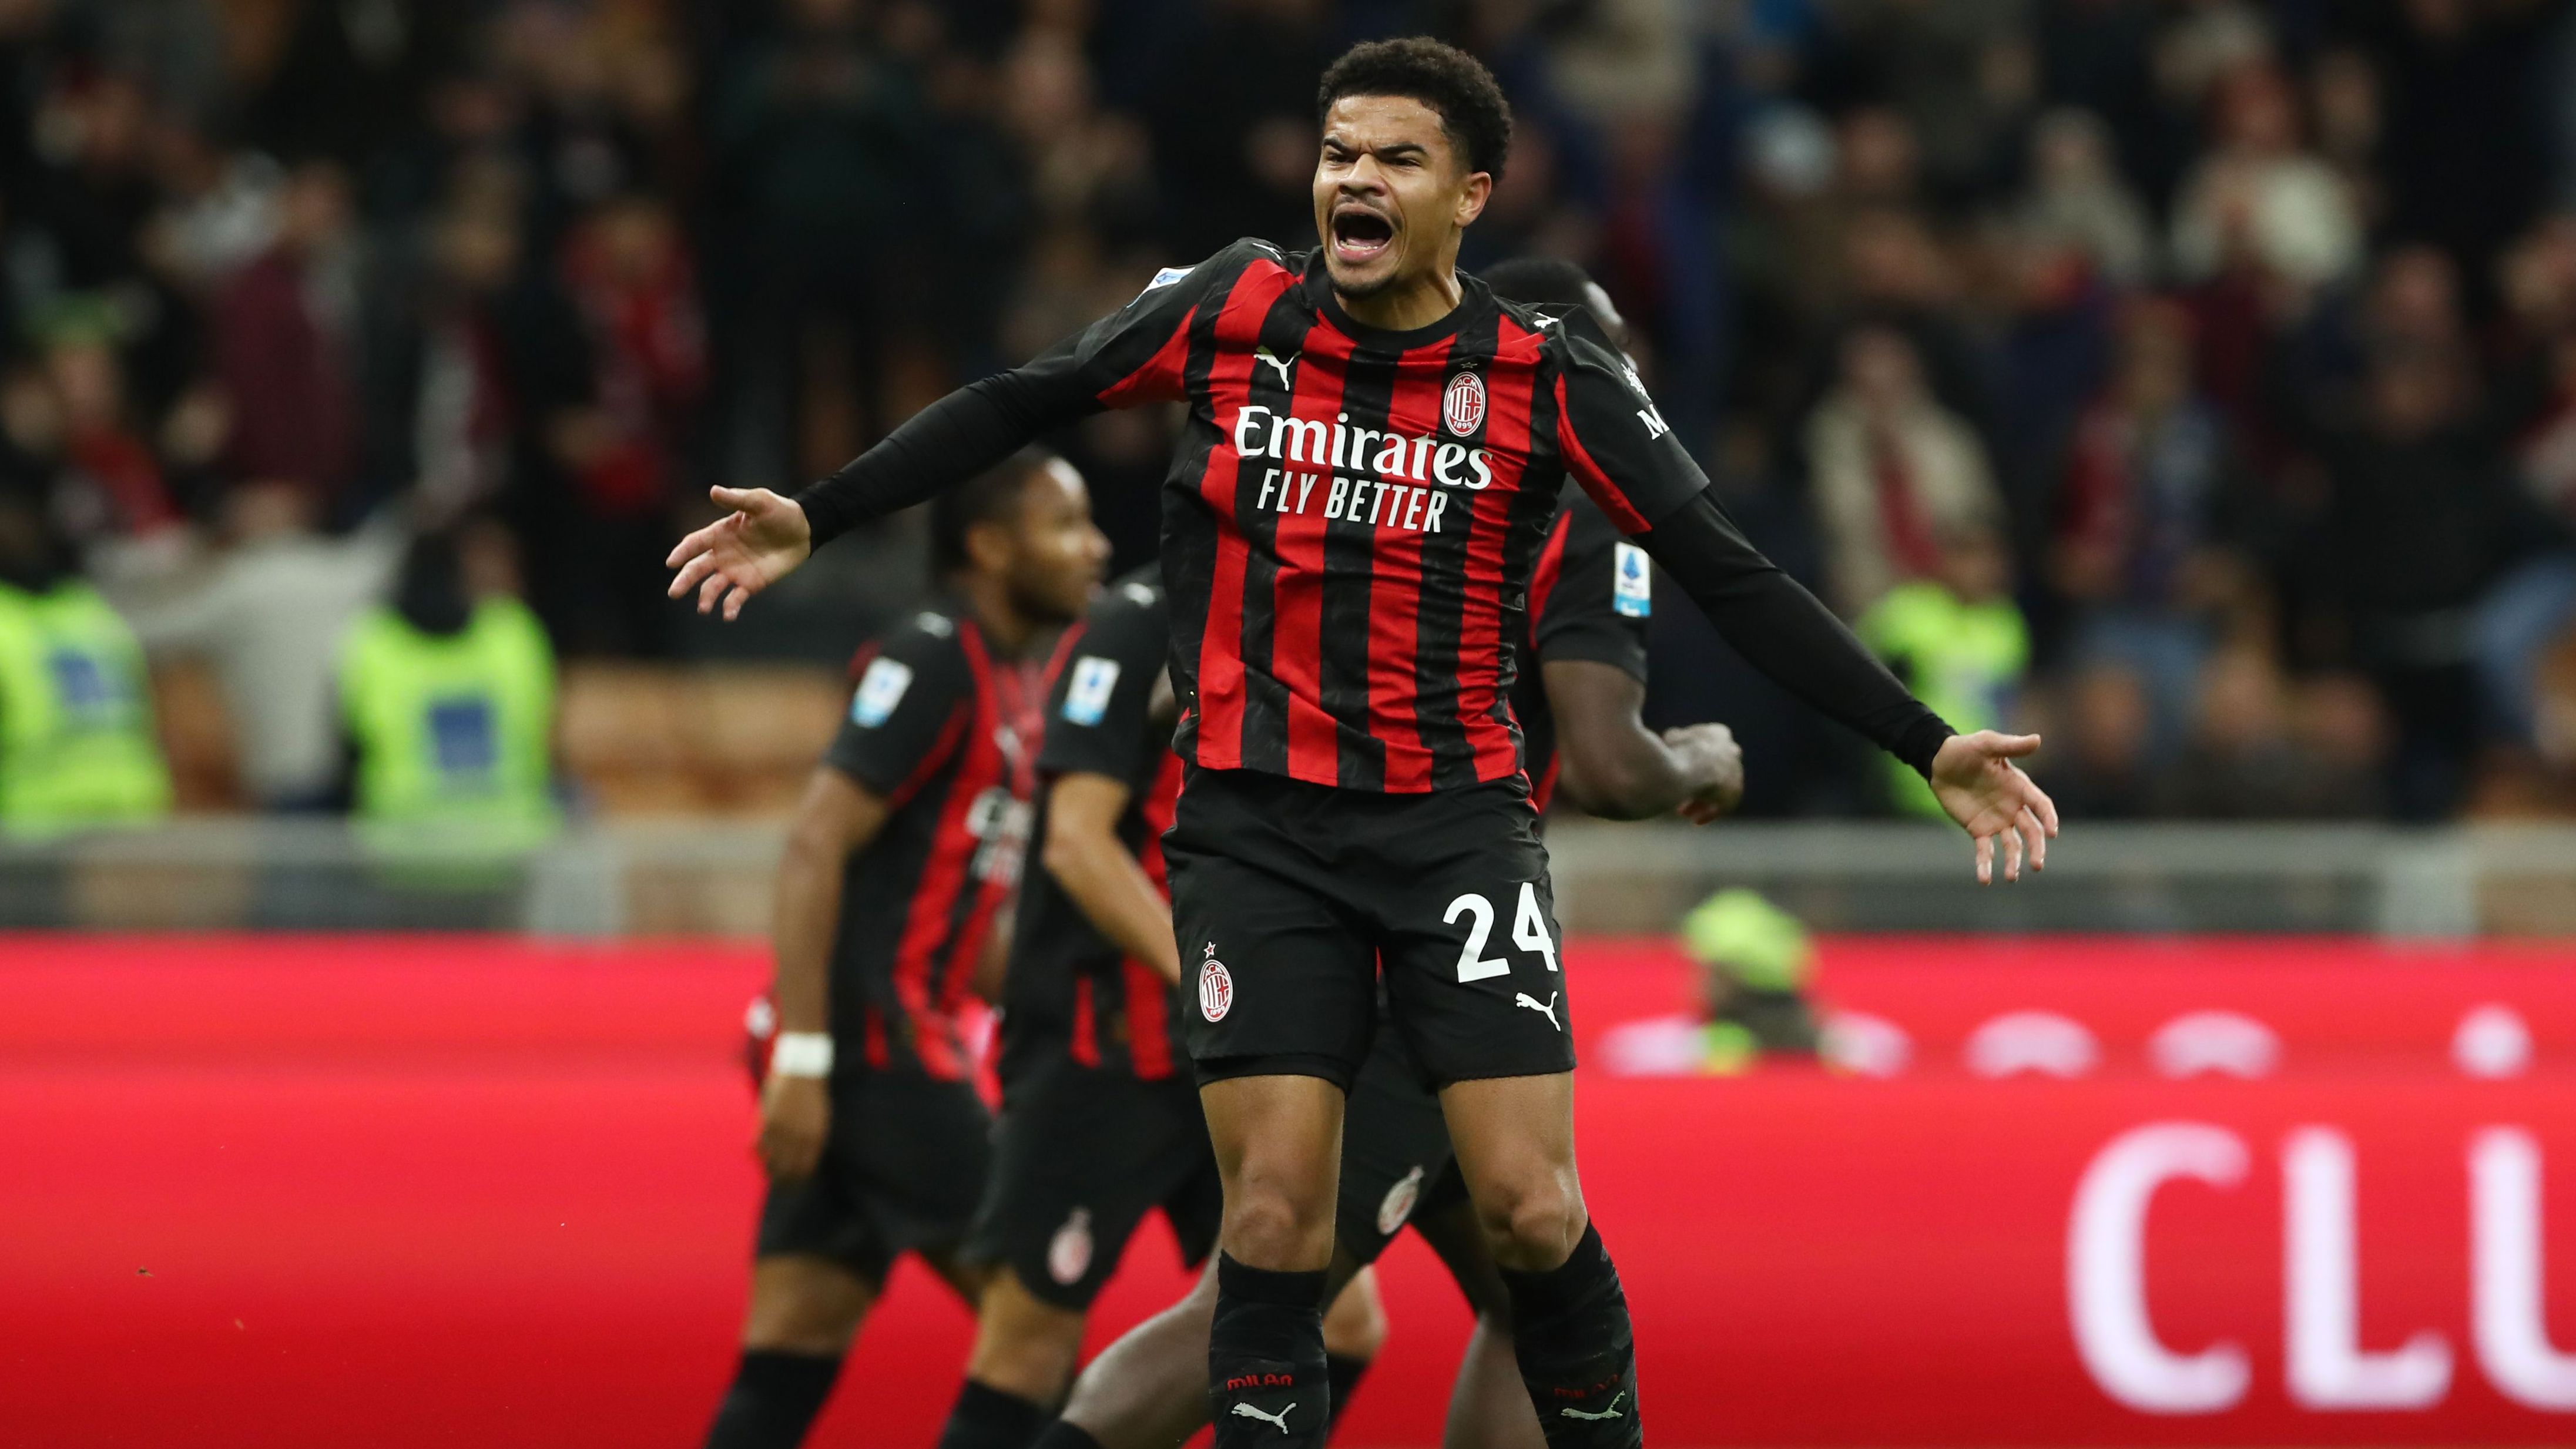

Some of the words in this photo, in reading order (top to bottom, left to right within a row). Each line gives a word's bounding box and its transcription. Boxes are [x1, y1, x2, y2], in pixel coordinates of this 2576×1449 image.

[1455, 377, 1477, 390] ACM
[1453, 421, 1473, 430] 1899
[1234, 405, 1493, 490] Emirates
[1257, 468, 1319, 514] FLY
[1324, 477, 1449, 533] BETTER
[1443, 882, 1558, 983] 24
[1205, 965, 1223, 980] ACM
[1210, 1007, 1225, 1016] 1899
